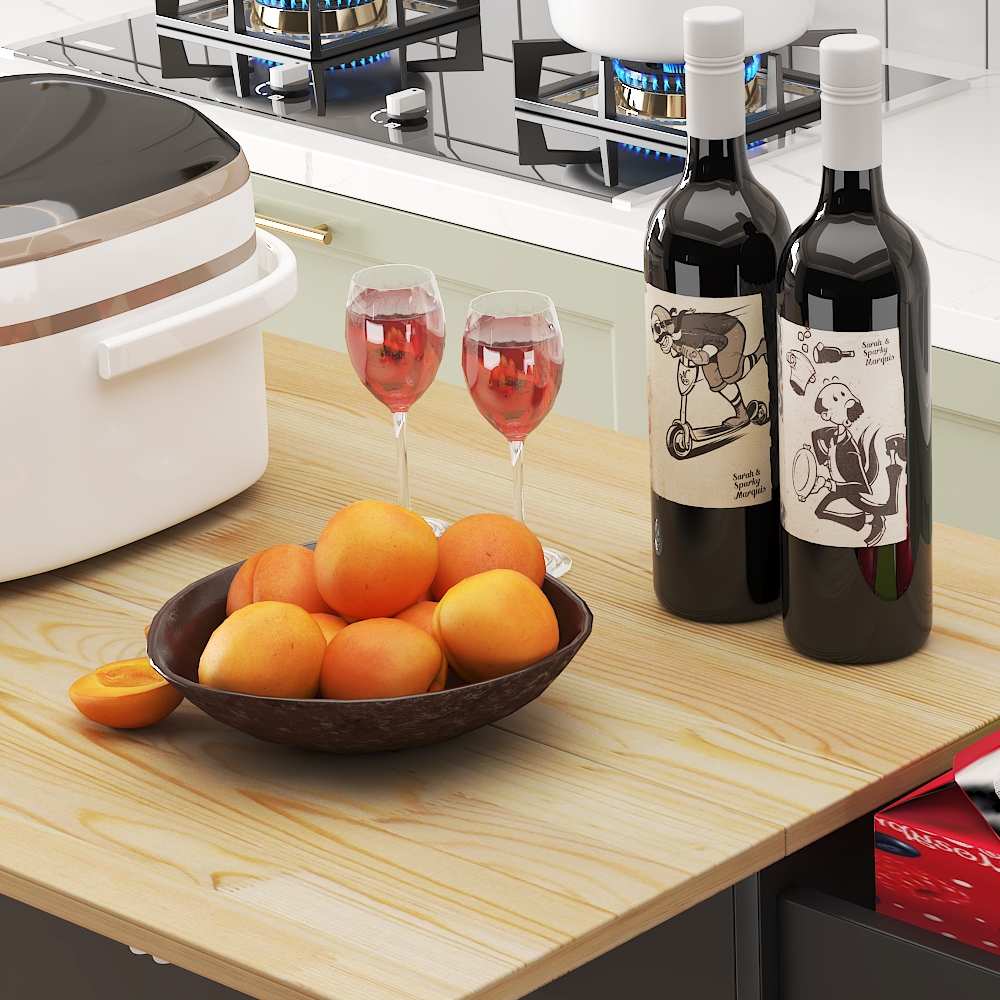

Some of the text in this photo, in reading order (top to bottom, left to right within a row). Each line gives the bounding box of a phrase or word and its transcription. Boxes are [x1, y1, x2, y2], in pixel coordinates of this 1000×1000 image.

[862, 339, 882, 349] Sarah
[863, 346, 888, 359] Sparky
[732, 470, 754, 481] Sarah
[734, 478, 761, 491] Sparky
[733, 486, 767, 500] Marquis
